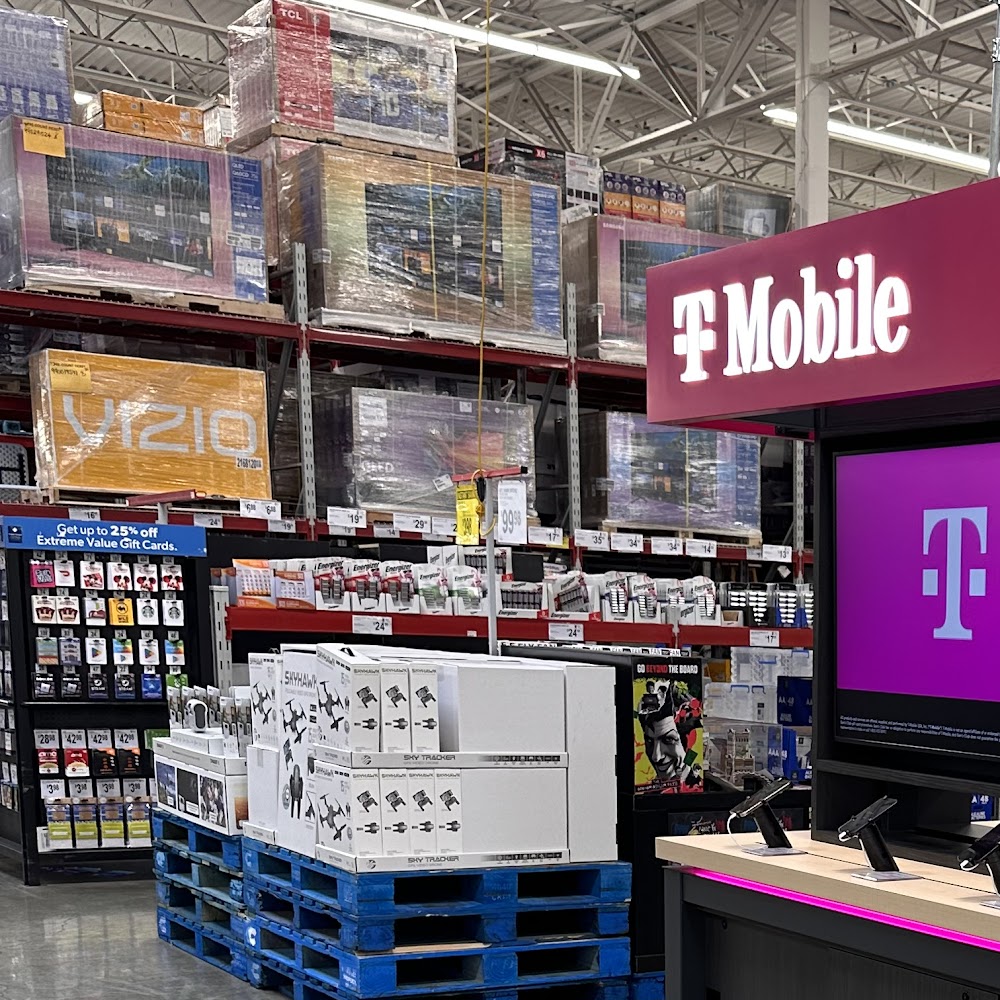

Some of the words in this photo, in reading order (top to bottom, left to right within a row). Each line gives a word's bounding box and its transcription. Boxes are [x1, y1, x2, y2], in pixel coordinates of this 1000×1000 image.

[279, 8, 303, 21] TCL
[722, 253, 912, 377] Mobile
[62, 394, 257, 458] VIZIO
[56, 524, 81, 536] Get
[80, 528, 95, 538] up
[96, 526, 108, 536] to
[110, 526, 138, 536] 25%
[140, 527, 158, 538] off
[36, 534, 86, 548] Extreme
[87, 536, 118, 548] Value
[120, 538, 140, 550] Gift
[142, 538, 178, 551] Cards.
[637, 664, 645, 673] GO
[668, 664, 679, 673] THE
[679, 664, 698, 673] BOARD
